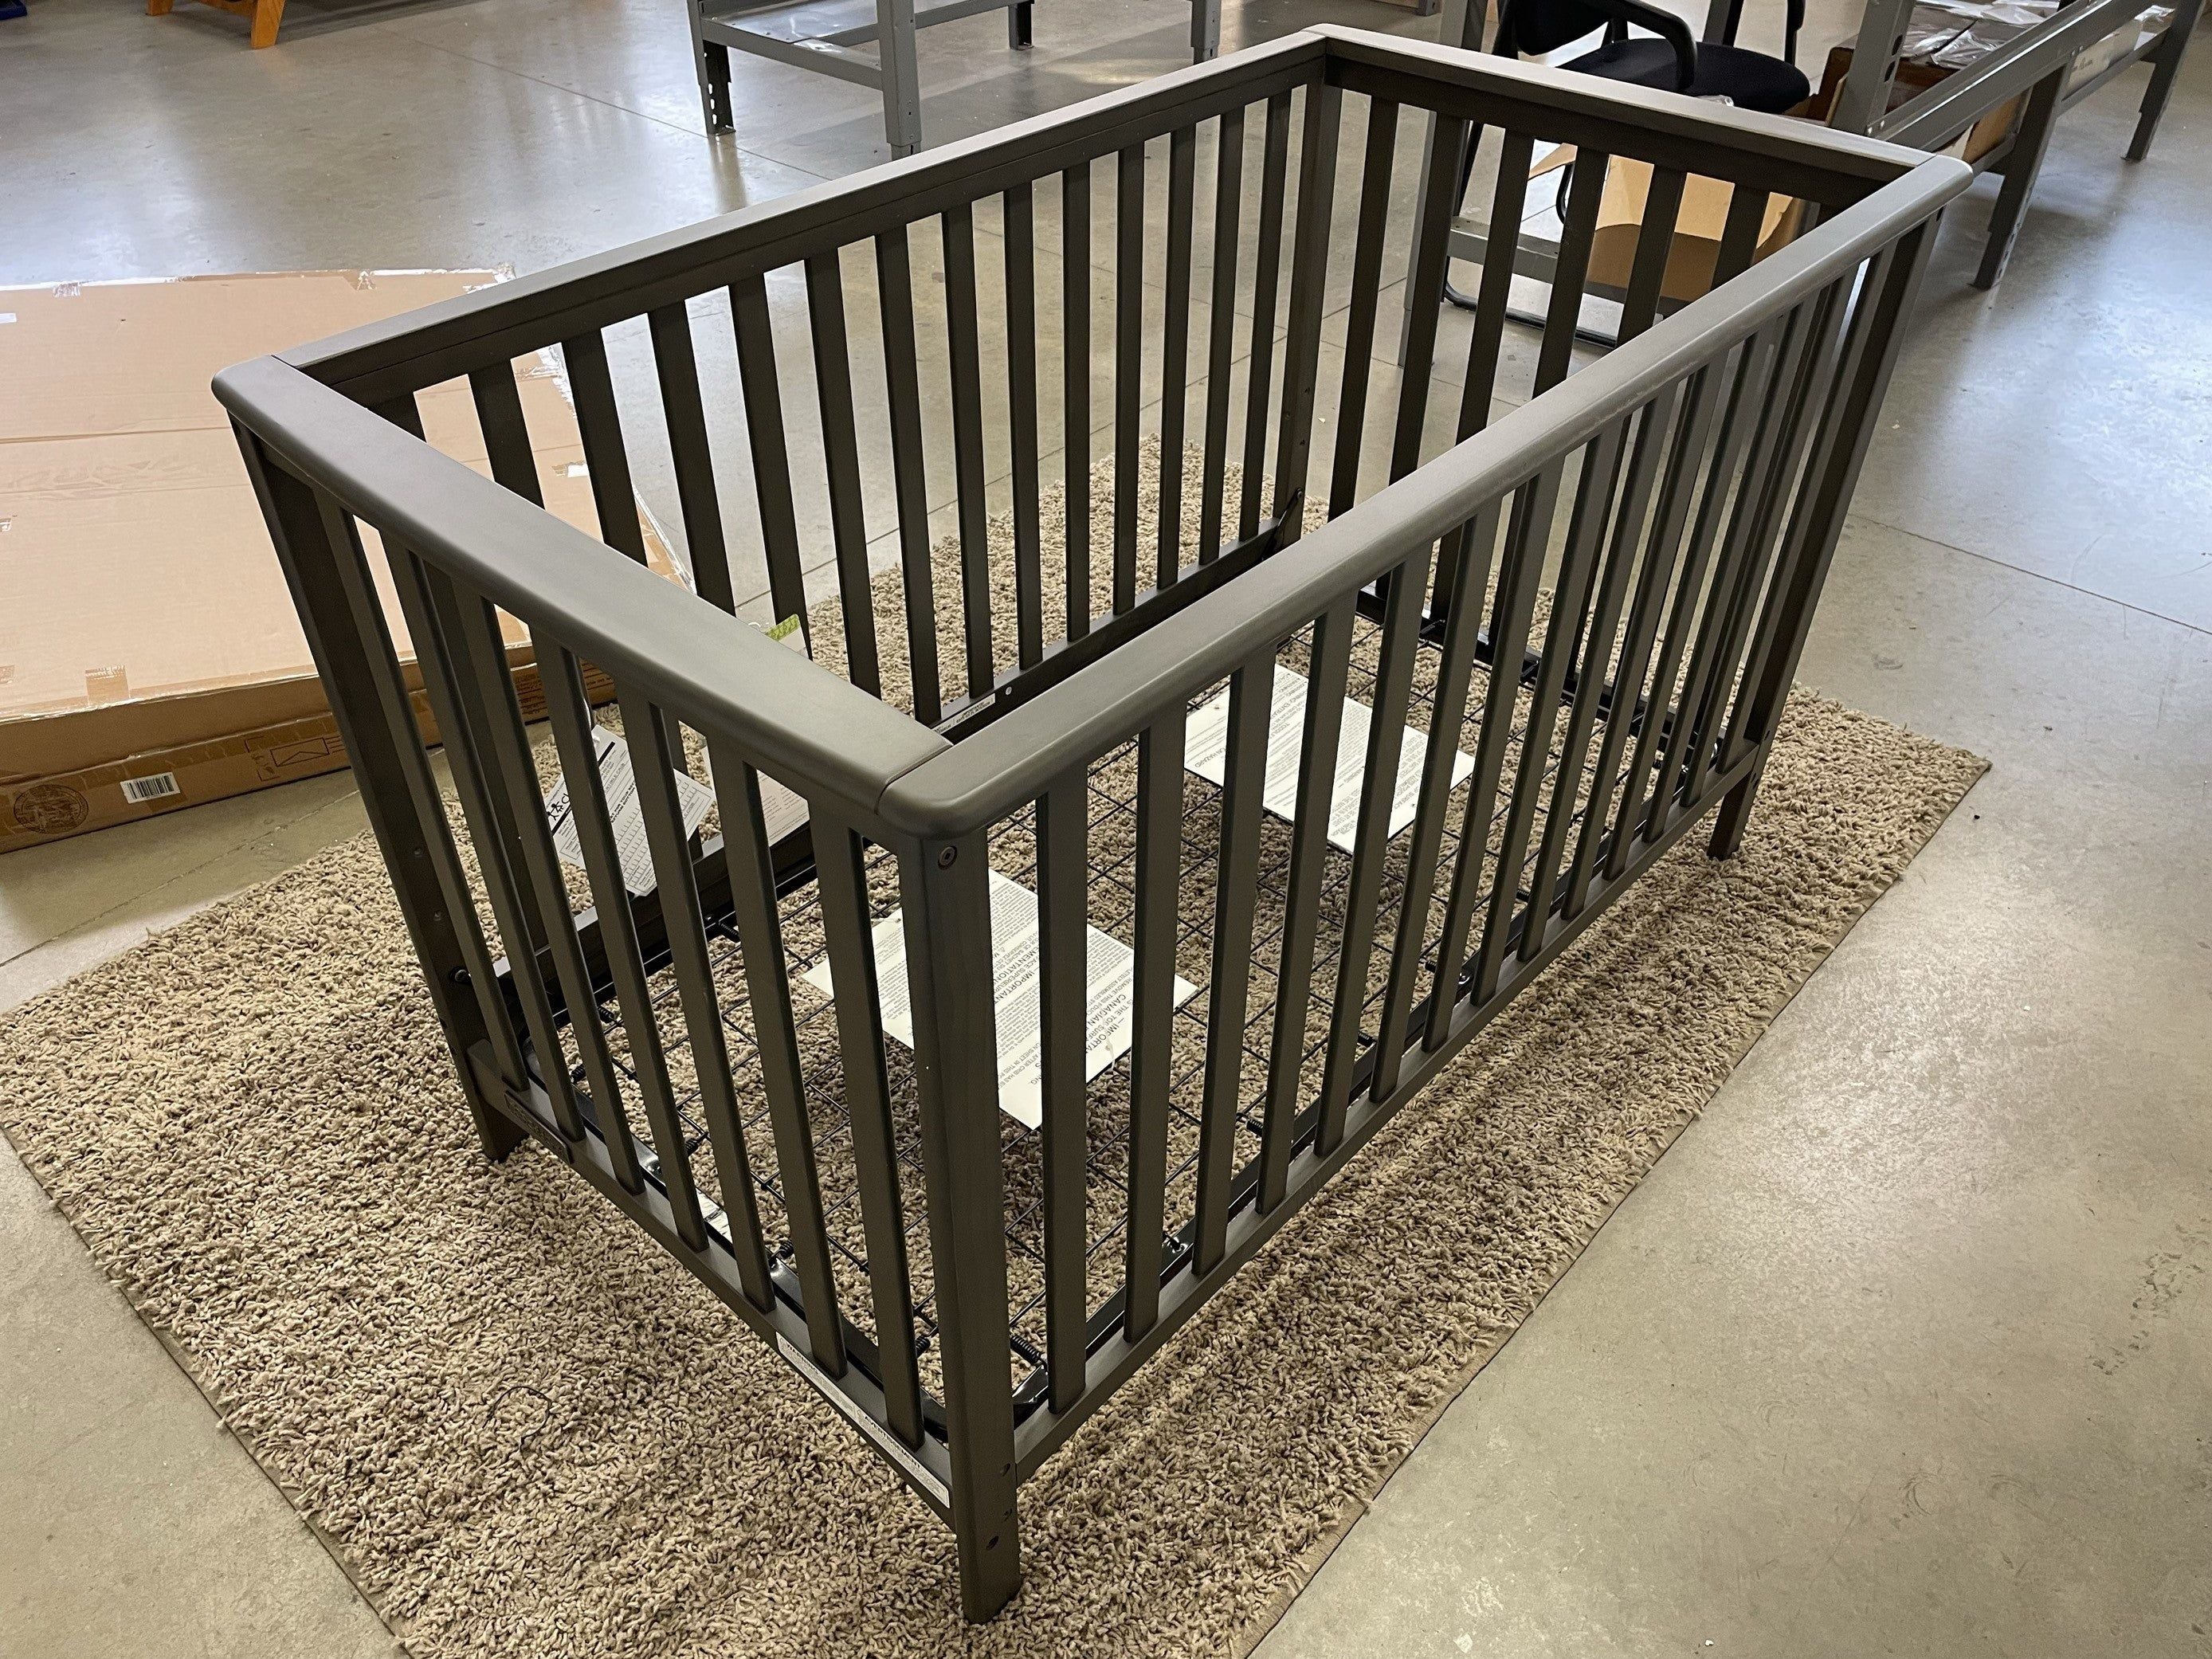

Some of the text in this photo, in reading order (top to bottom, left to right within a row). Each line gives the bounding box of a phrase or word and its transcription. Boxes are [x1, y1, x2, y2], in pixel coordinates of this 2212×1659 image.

[991, 945, 1040, 985] EMENTATION
[991, 969, 1036, 1006] IMPORTANT
[1091, 979, 1120, 1001] ASSEMBLED
[1085, 992, 1128, 1027] CANADIAN
[1112, 1003, 1130, 1016] THE
[1085, 1023, 1106, 1043] SURFA
[1085, 1022, 1120, 1055] IMPORTA
[1016, 1047, 1035, 1062] SHEET
[1001, 1063, 1015, 1074] THIS
[1002, 1073, 1016, 1083] HAS
[1011, 1064, 1026, 1076] CRIB
